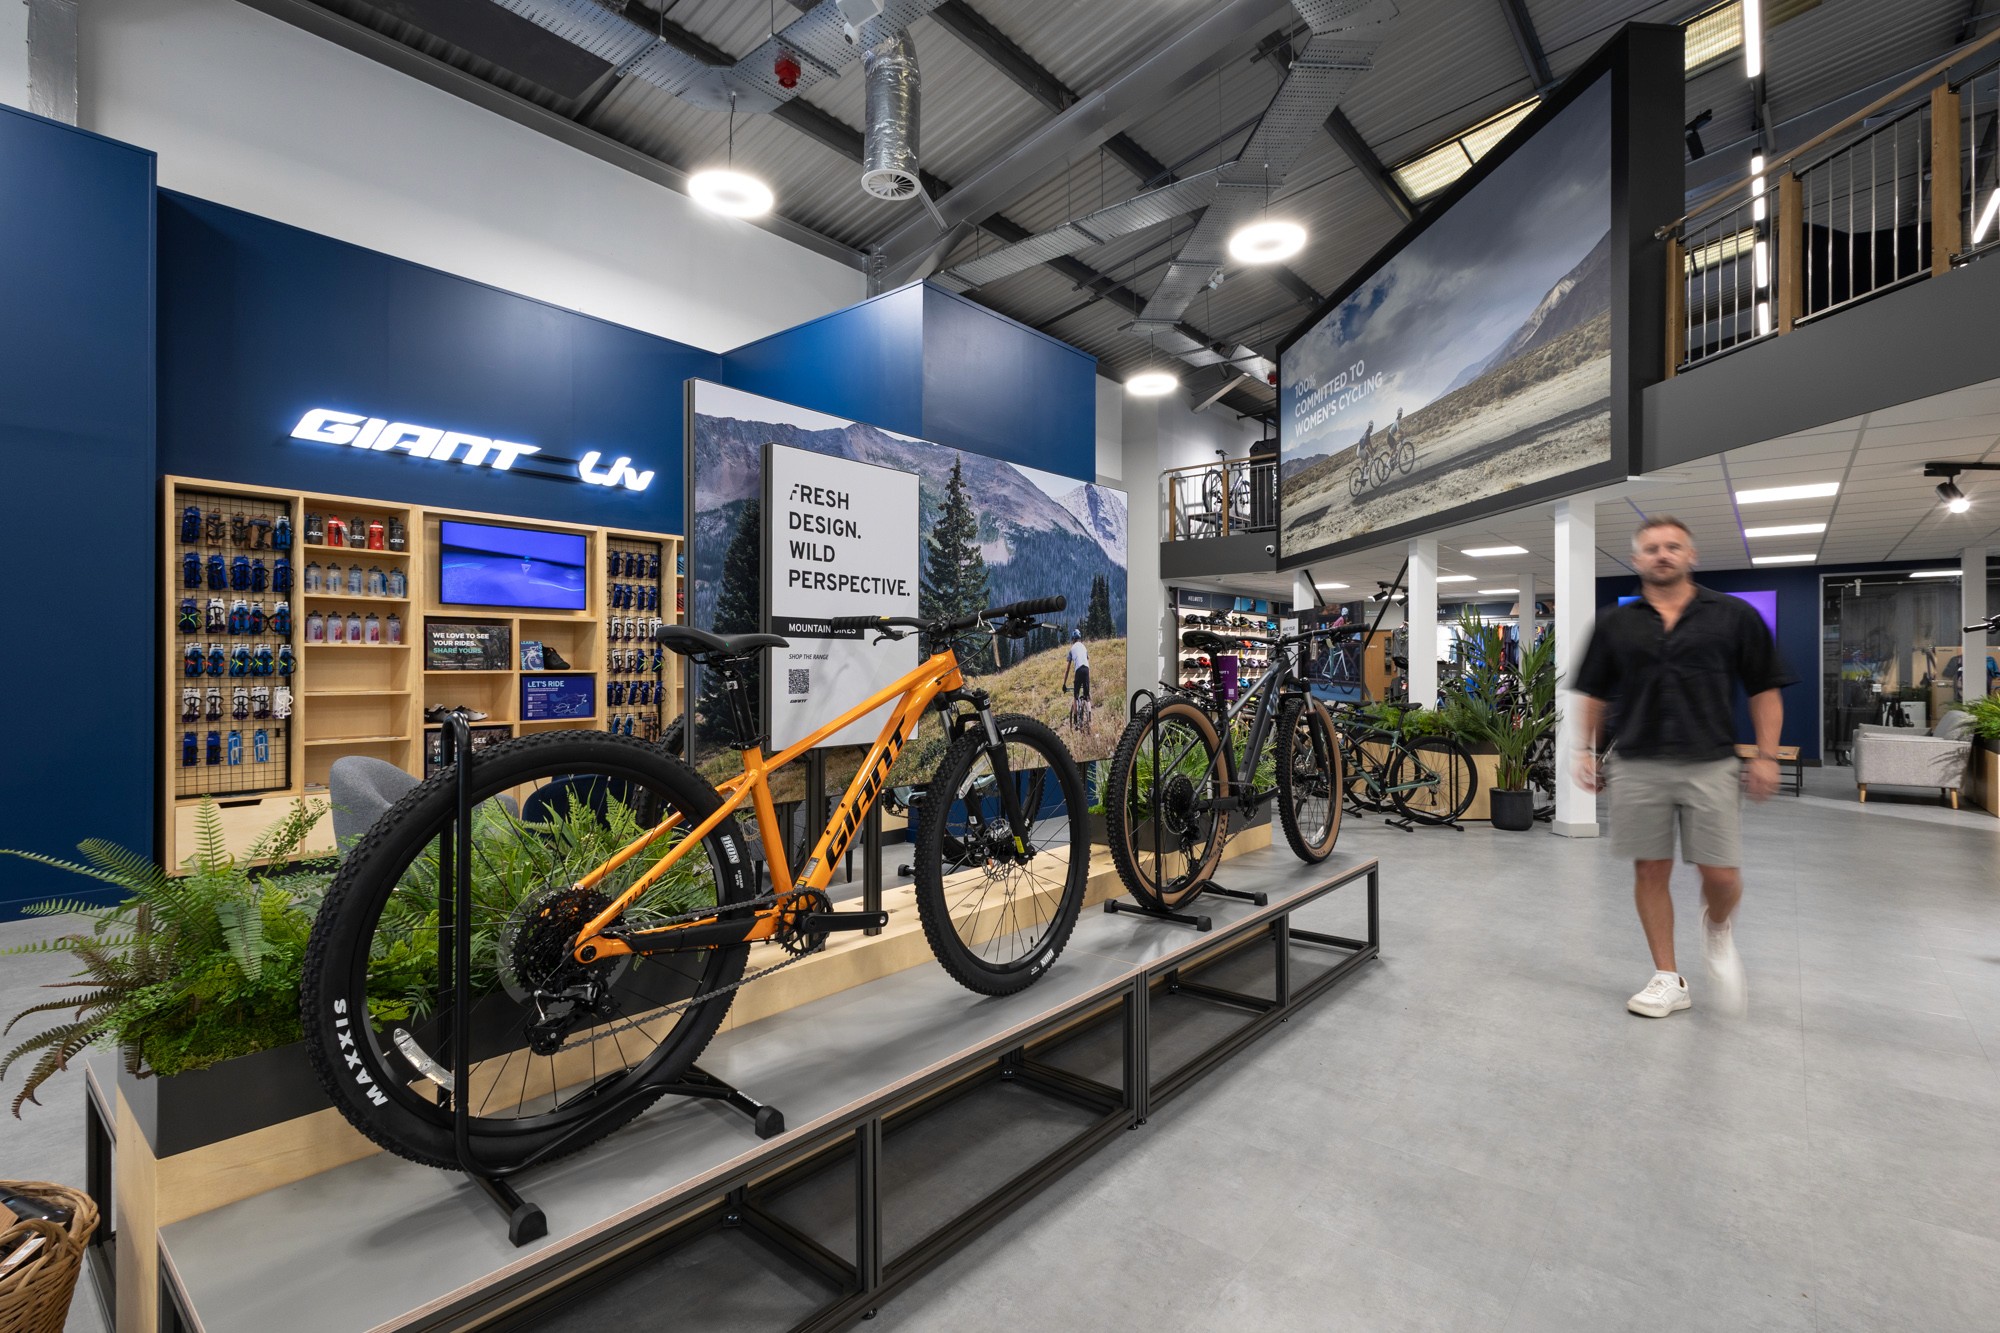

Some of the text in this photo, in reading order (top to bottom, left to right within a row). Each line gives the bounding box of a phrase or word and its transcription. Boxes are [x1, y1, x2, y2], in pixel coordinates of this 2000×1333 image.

[1295, 373, 1317, 398] 100%
[1295, 360, 1364, 417] COMMITTED TO
[1295, 372, 1383, 437] WOMEN'S CYCLING
[290, 408, 542, 470] GIANT
[789, 483, 850, 510] FRESH
[789, 511, 862, 539] DESIGN.
[789, 540, 836, 562] WILD
[788, 569, 911, 597] PERSPECTIVE.
[788, 623, 832, 633] MOUNTAIN
[547, 680, 565, 688] RIDE
[825, 715, 905, 872] GIANT
[334, 998, 389, 1107] MAXXIS
